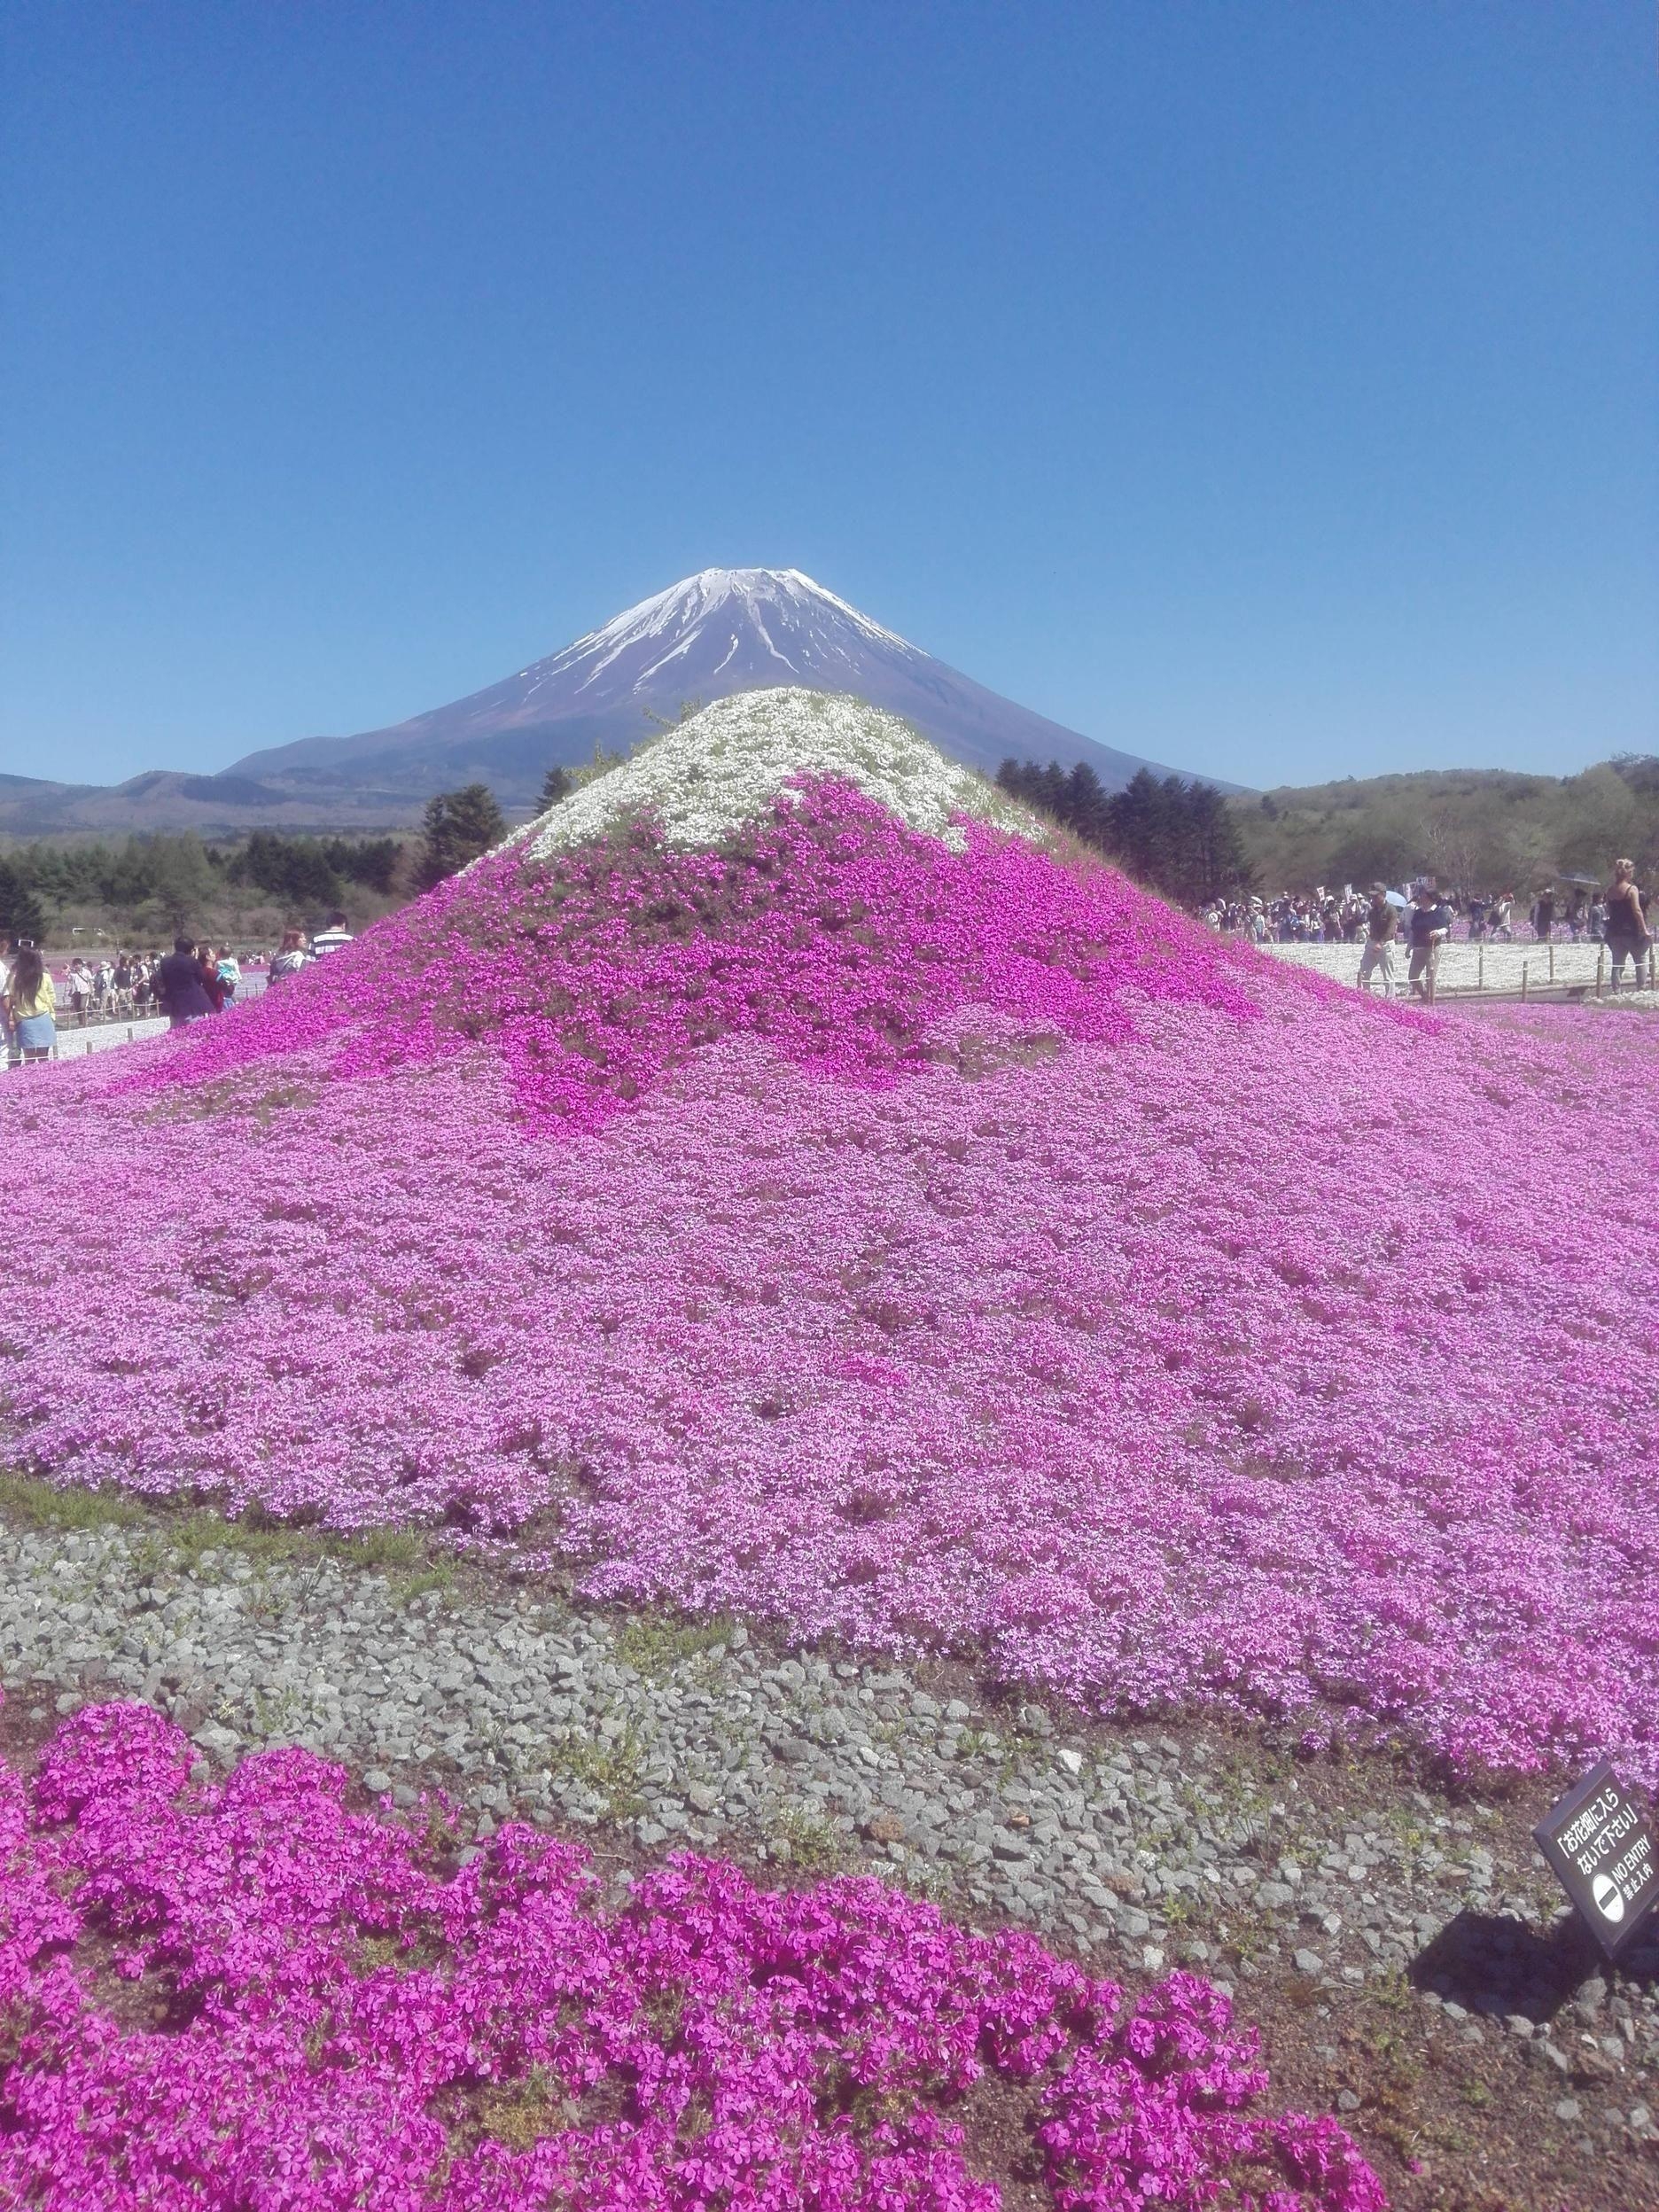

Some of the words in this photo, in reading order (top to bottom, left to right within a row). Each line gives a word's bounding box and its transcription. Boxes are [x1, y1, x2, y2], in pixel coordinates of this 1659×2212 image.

[1611, 1862, 1628, 1885] NO
[1624, 1834, 1651, 1870] ENTRY
[1623, 1863, 1654, 1900] 禁止入内
